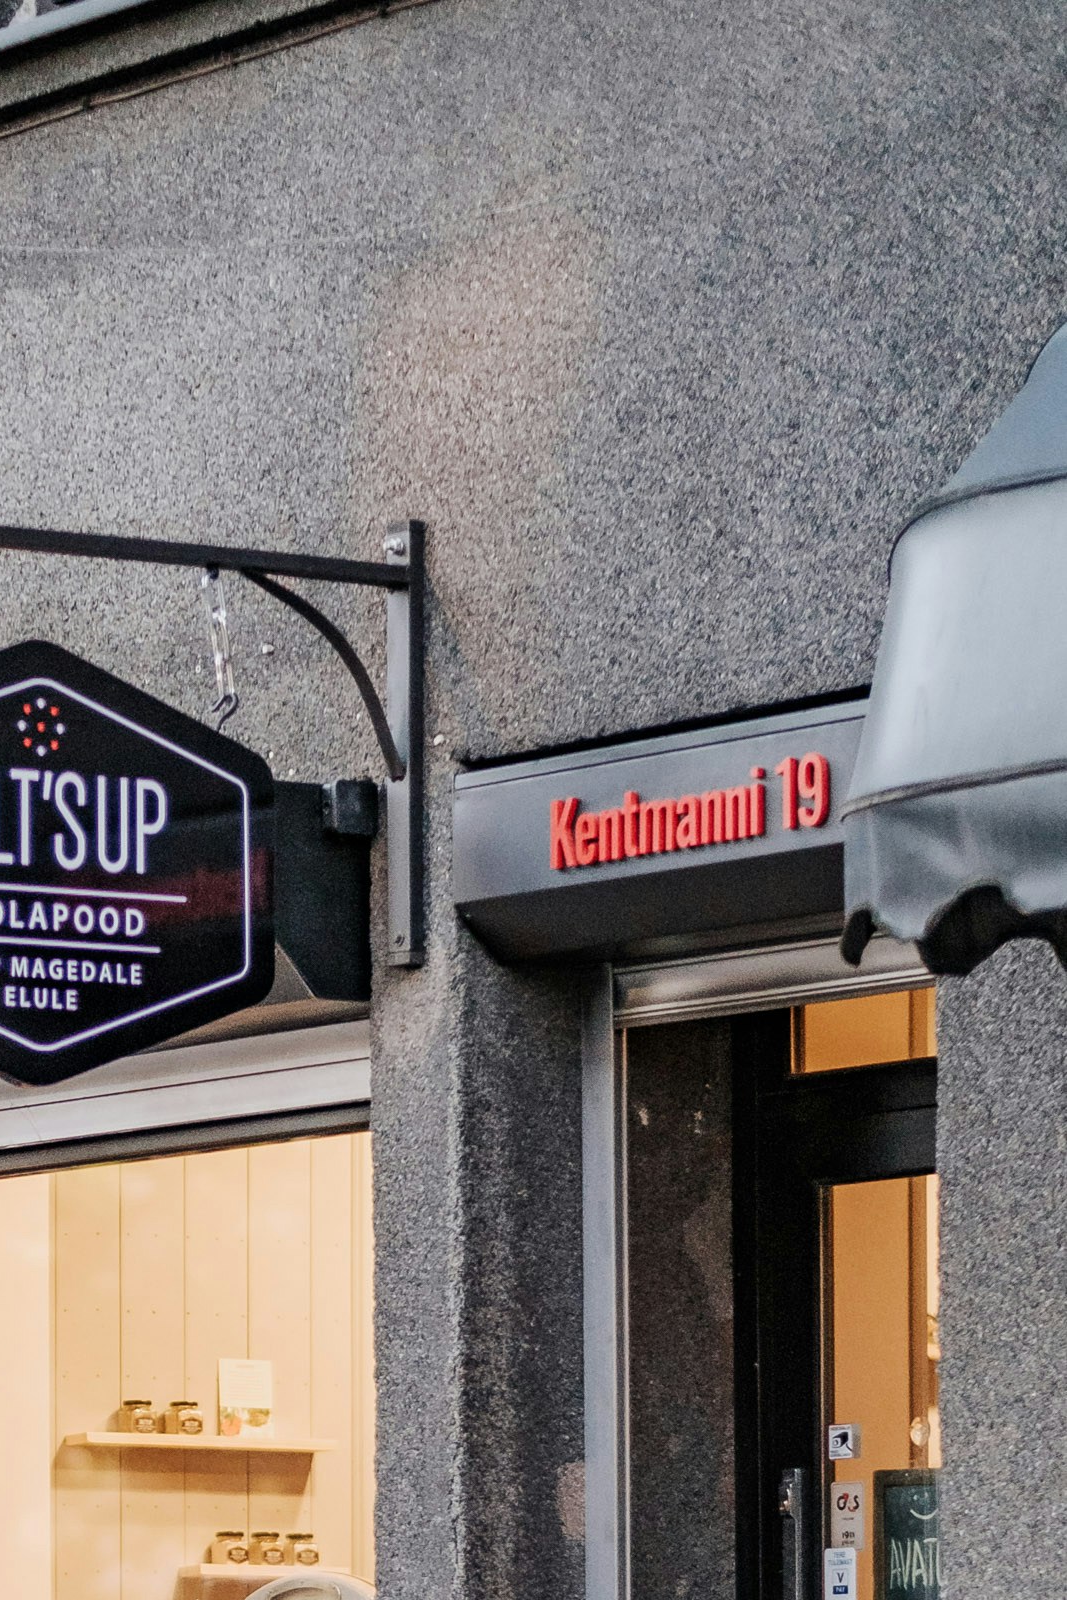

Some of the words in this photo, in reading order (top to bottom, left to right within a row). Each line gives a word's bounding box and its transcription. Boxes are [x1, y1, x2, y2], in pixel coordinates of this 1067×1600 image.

[550, 767, 766, 870] Kentmanni
[775, 752, 831, 830] 19
[10, 956, 143, 985] MAGEDALE
[4, 985, 79, 1011] ELULE
